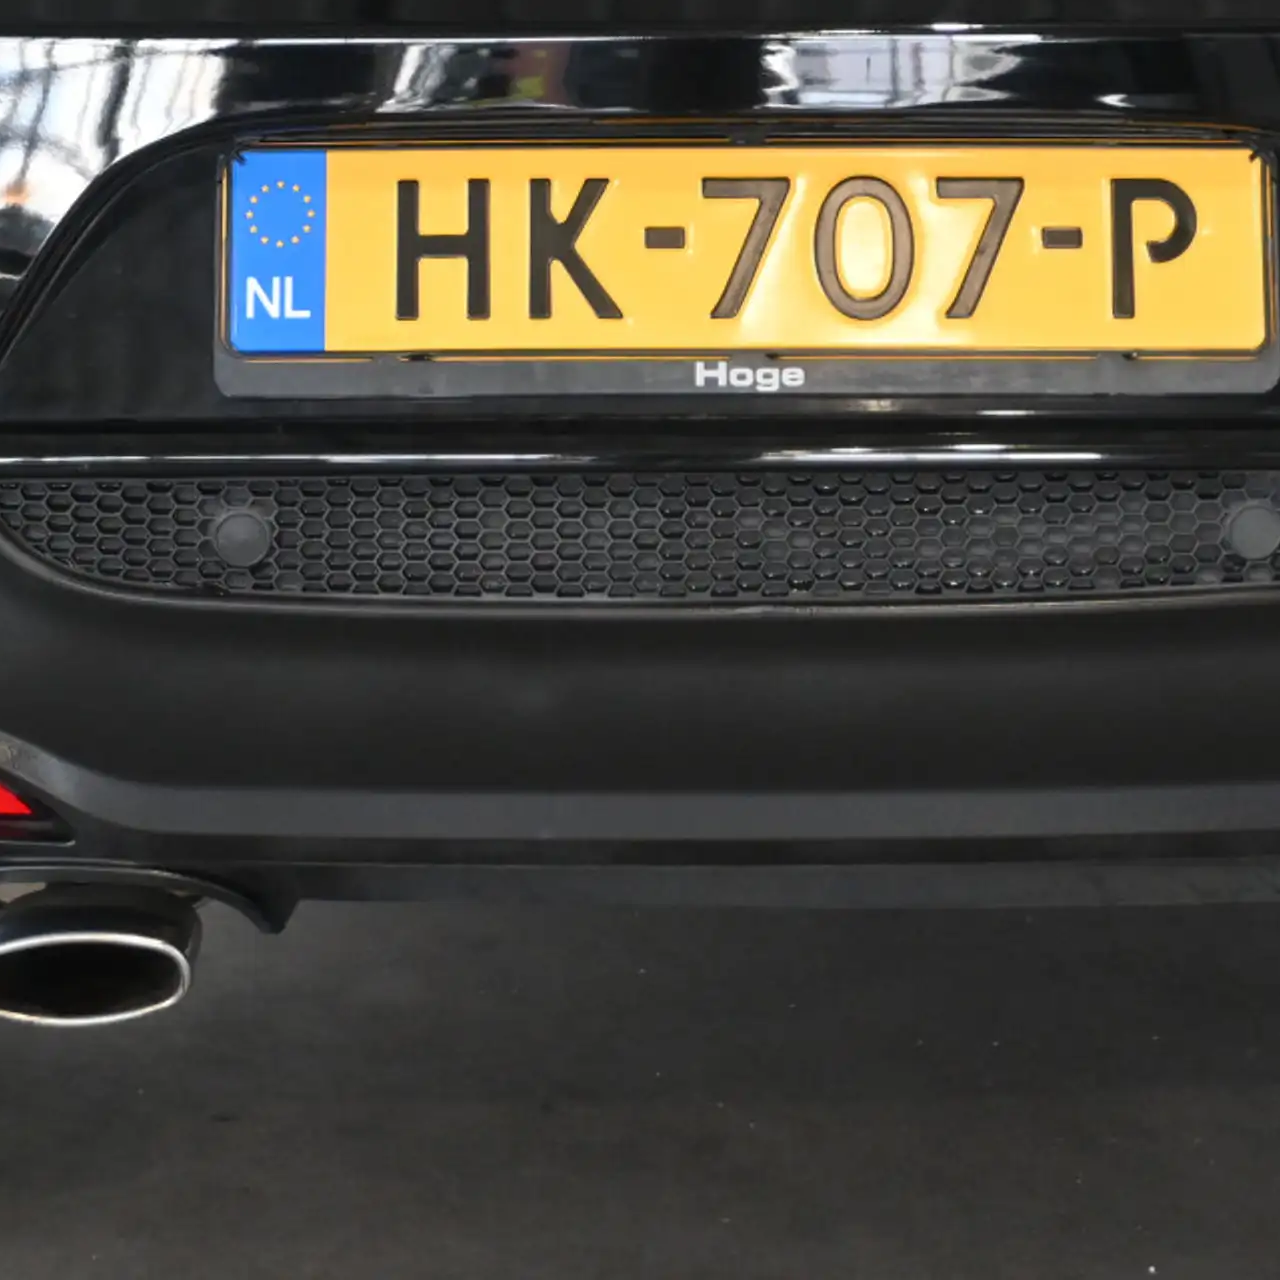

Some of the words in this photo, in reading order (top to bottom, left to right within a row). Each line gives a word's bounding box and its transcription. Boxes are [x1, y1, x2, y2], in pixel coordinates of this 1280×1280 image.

[394, 175, 1198, 321] HK-707-P
[245, 277, 311, 319] NL
[694, 360, 805, 392] Hoge
